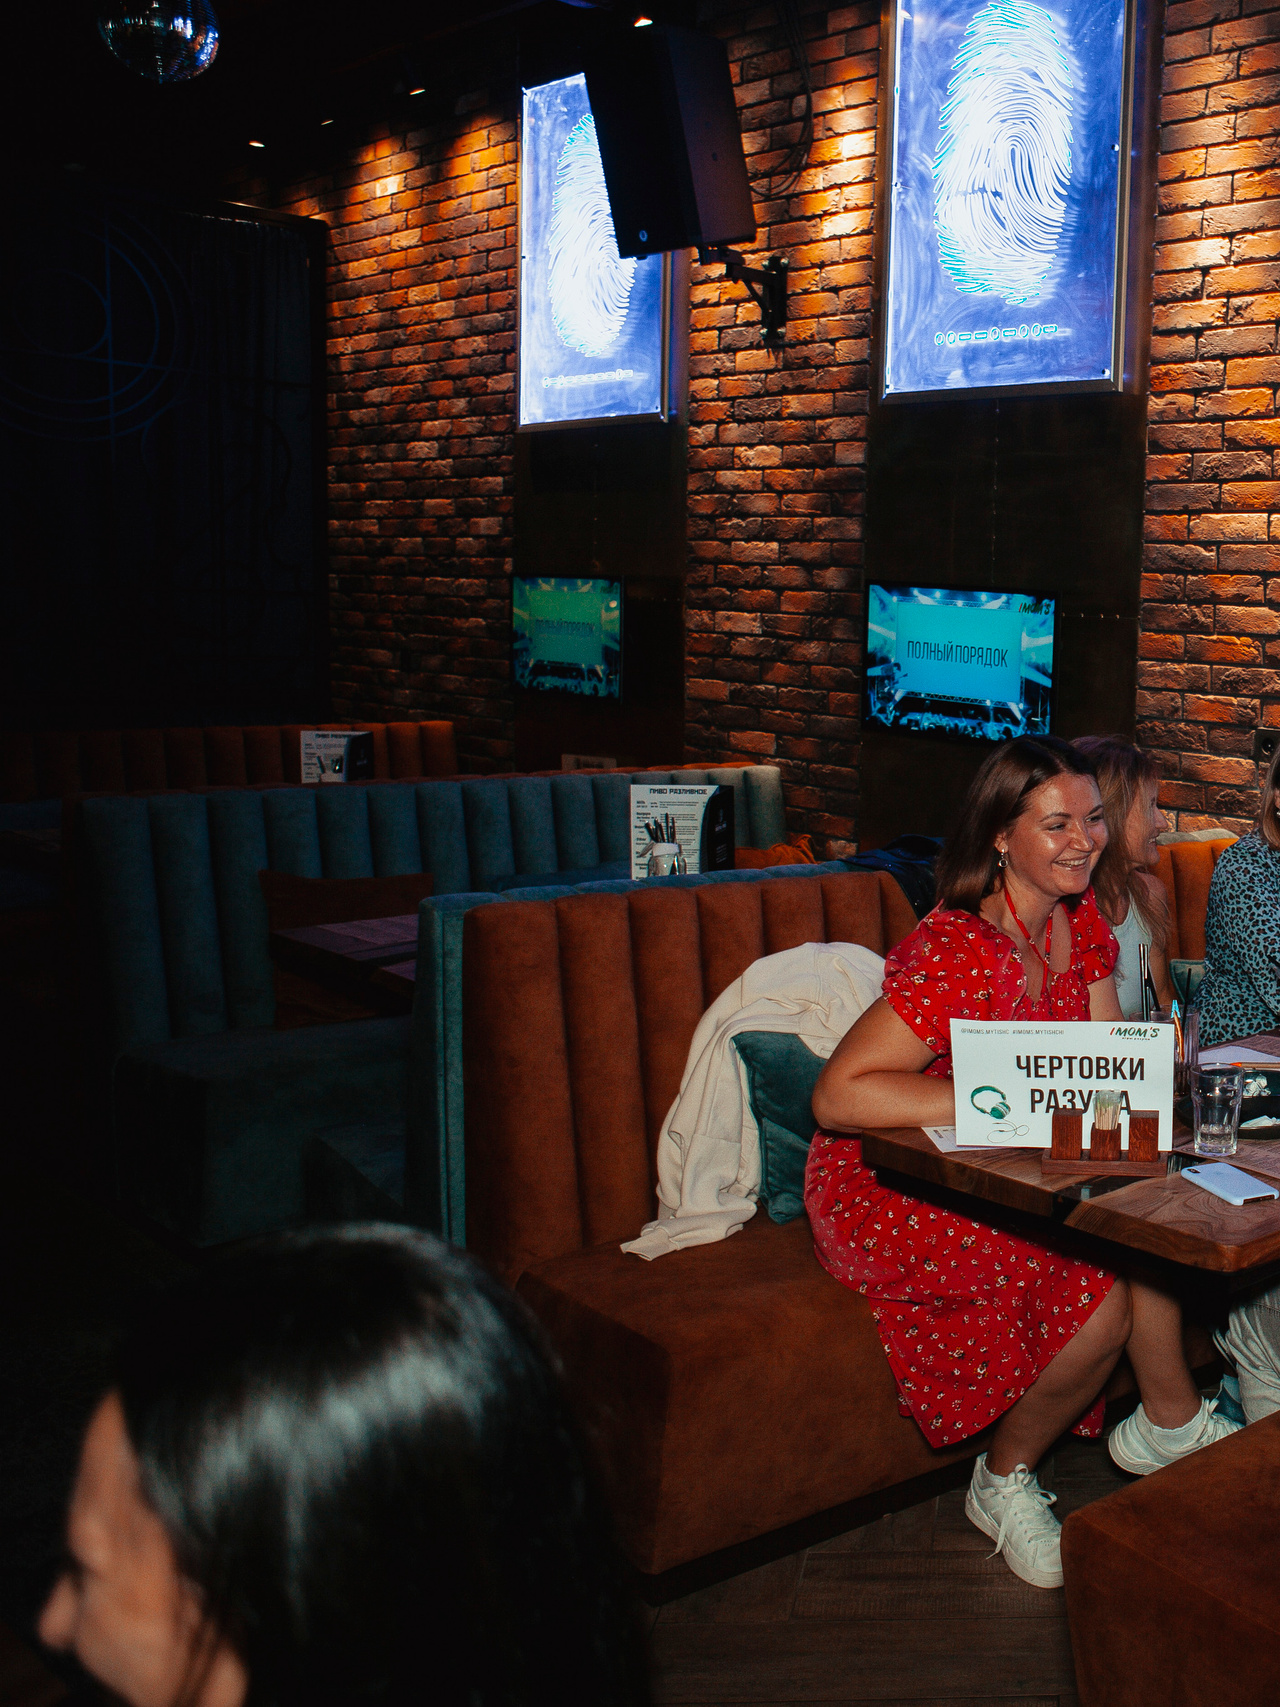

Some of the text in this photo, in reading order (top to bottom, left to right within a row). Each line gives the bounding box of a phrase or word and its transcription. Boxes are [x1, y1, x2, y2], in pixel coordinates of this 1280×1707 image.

[907, 640, 1008, 668] ПОЛНЫЙ ПОРЯДОК
[1110, 1026, 1160, 1038] IMOM'S
[1016, 1055, 1145, 1081] ЧЕРТОВКИ
[1030, 1088, 1132, 1115] РАЗУА
